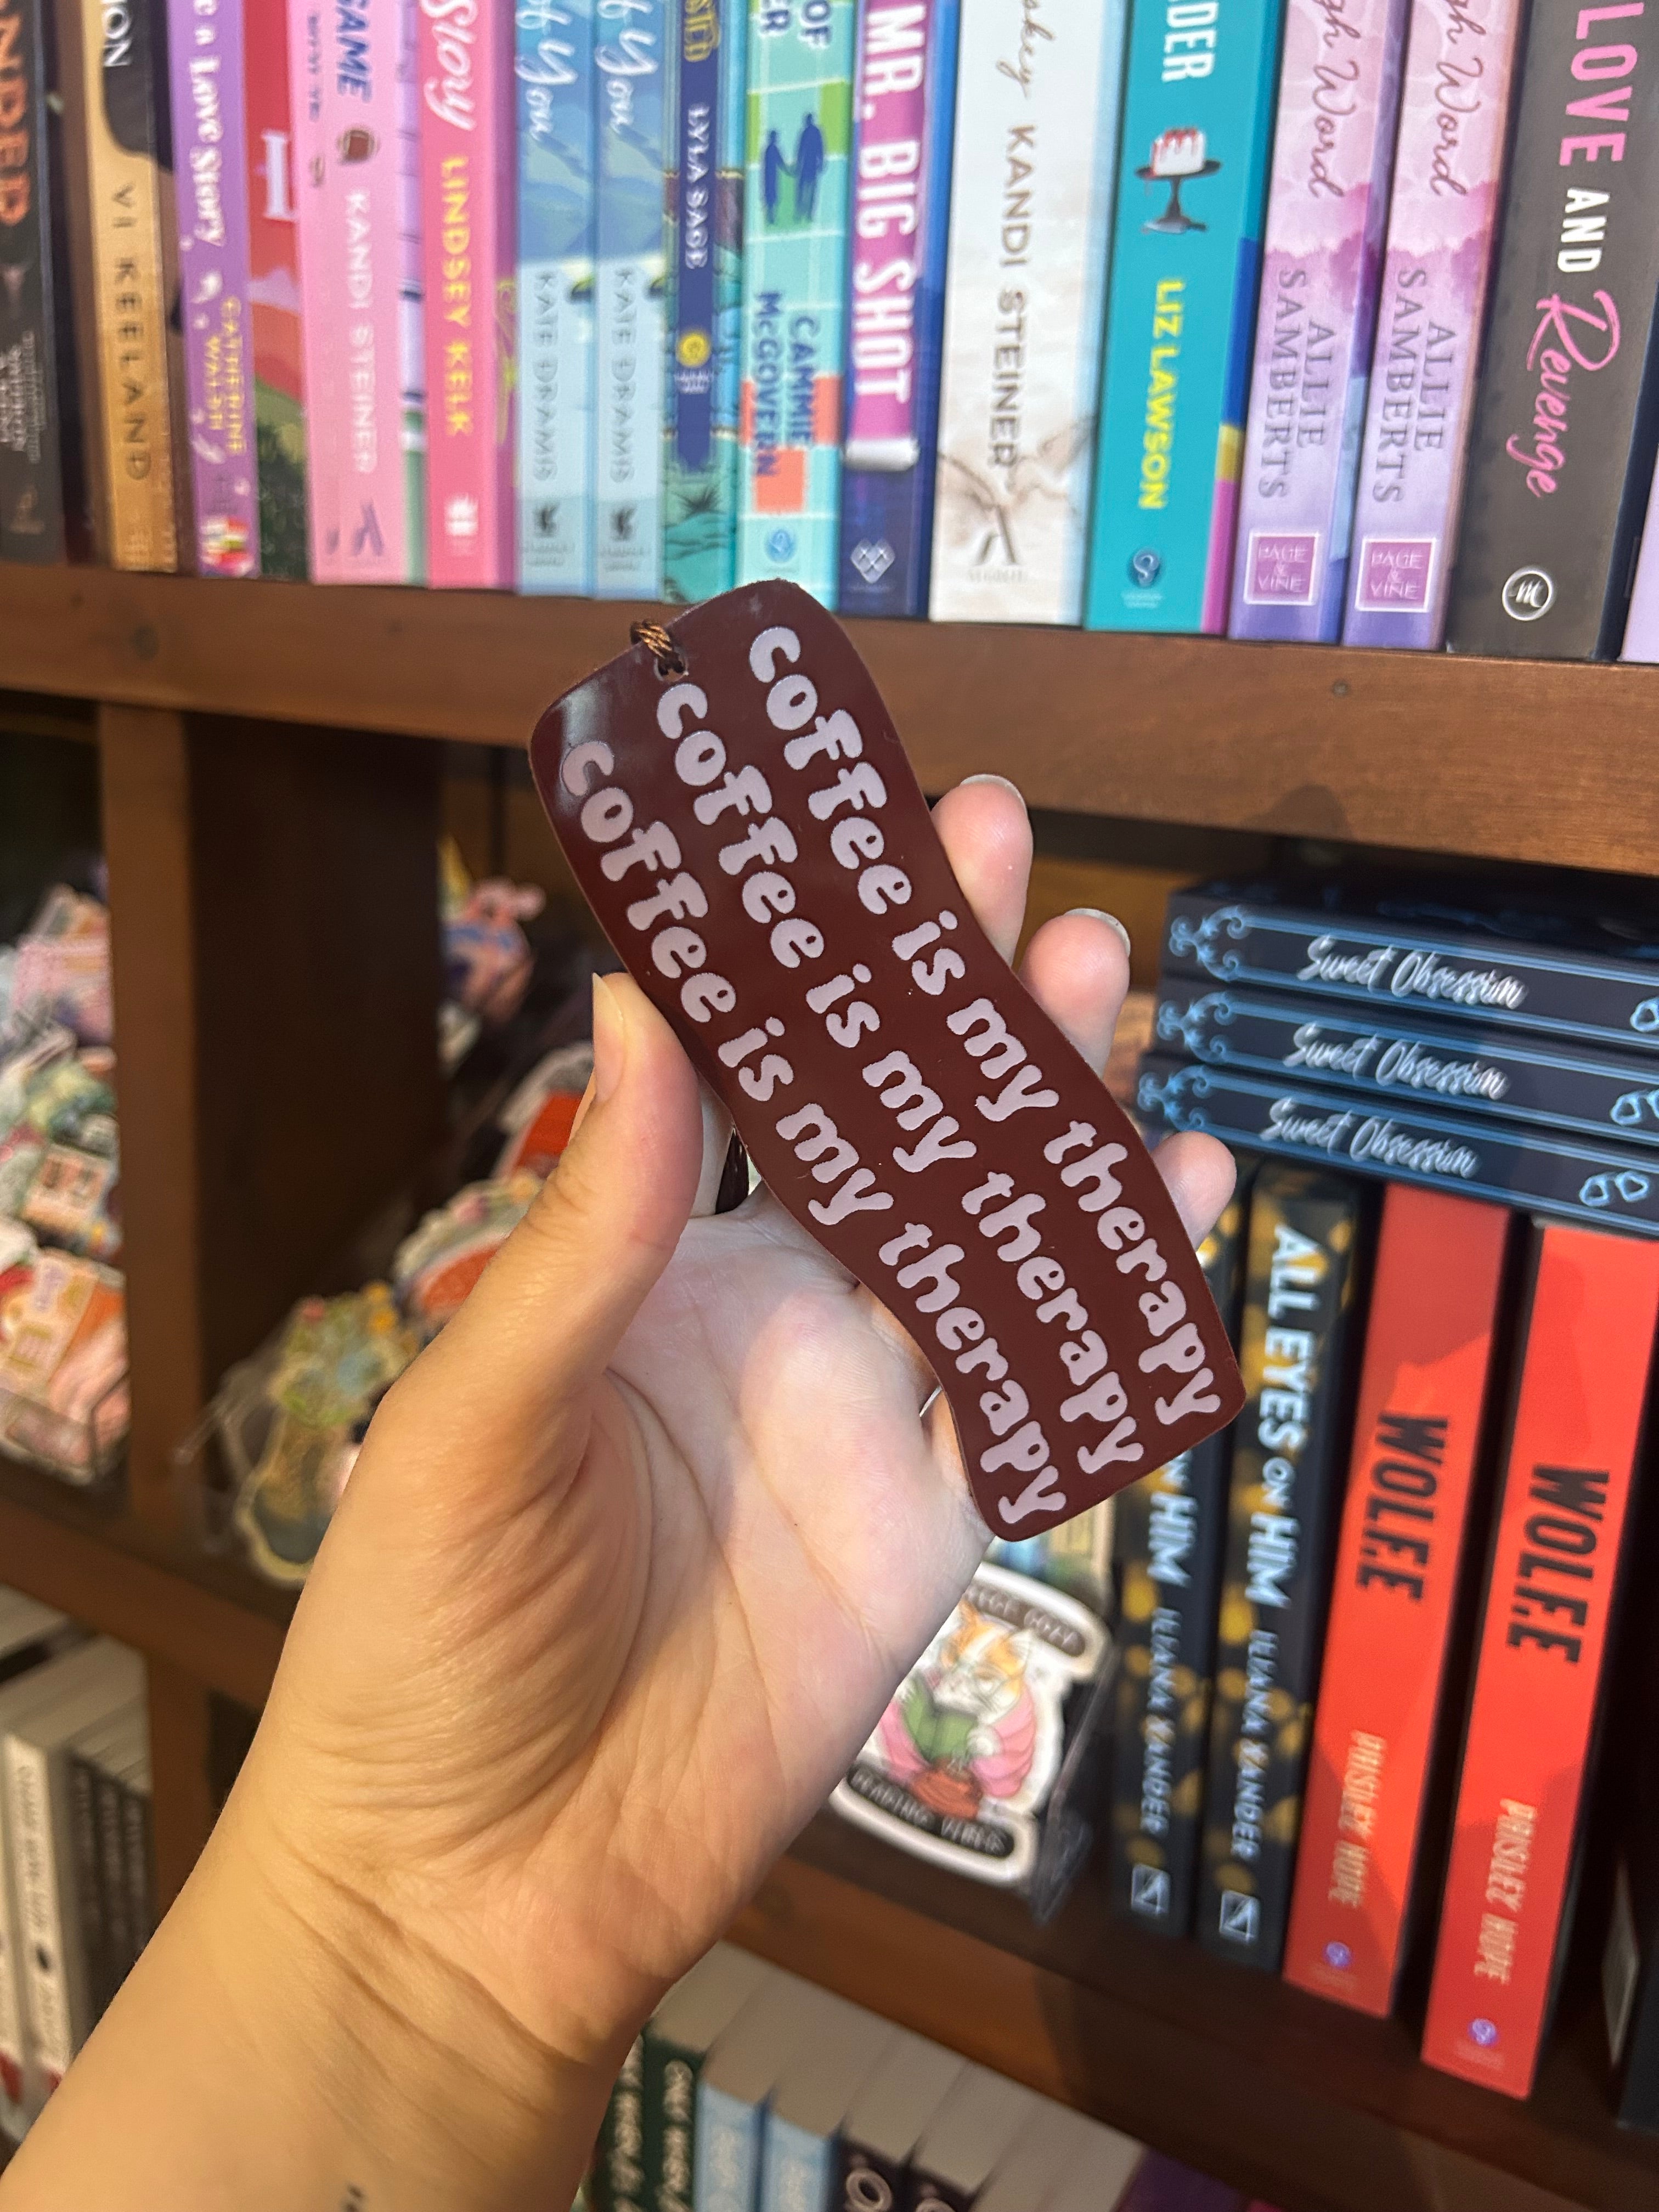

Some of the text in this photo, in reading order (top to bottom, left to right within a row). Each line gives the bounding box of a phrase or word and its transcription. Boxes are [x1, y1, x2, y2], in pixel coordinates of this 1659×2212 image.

[101, 0, 132, 67] ON
[336, 0, 373, 103] AME
[514, 38, 578, 142] You
[594, 28, 658, 135] You
[1161, 0, 1219, 82] DER
[190, 57, 223, 143] Love
[1308, 60, 1359, 198] Word
[1430, 57, 1483, 196] Word
[190, 147, 225, 247] Story
[685, 104, 709, 269] LYLA SAGE
[851, 4, 927, 403] MR. BIG SHOT
[1000, 123, 1037, 268] KANDI
[1506, 2, 1644, 499] LOVE AND Revenge
[112, 183, 152, 481] VI KEELAND
[346, 190, 377, 473] KANDI STEINER
[441, 156, 474, 437] LINDSEY KELK
[533, 270, 558, 347] KATE
[611, 267, 637, 346] KATE
[788, 313, 821, 441] CAMMIE
[991, 287, 1030, 469] STEINER
[1139, 279, 1184, 510] LIZ LAWSON
[1259, 267, 1307, 498] SAMBERTS
[1296, 320, 1335, 449] ALLIE
[1371, 268, 1427, 503] SAMBERTS
[1414, 320, 1457, 451] ALLIE
[1257, 575, 1306, 594] VINE
[1258, 543, 1307, 565] PAGE
[1370, 579, 1420, 600] VINE
[1372, 549, 1423, 570] PAGE
[749, 626, 912, 915] coffee
[892, 910, 966, 995] is
[946, 998, 1059, 1122] my
[1043, 1120, 1221, 1425] therapy
[1297, 934, 1529, 1011] Sweet Obsession
[657, 683, 824, 968] coffee
[806, 963, 881, 1048] is
[862, 1050, 977, 1173] my
[961, 1172, 1144, 1474] therapy
[1283, 1022, 1510, 1101] Sweet Obsession
[561, 741, 1066, 1524] coffee is my therapy
[1260, 1097, 1482, 1180] Sweet Obsession
[1244, 1223, 1329, 1610] ALL EYES ON HIM
[1147, 1490, 1198, 1588] HIM
[1328, 1839, 1368, 1909] HOPE
[1474, 1912, 1519, 1985] HOPE
